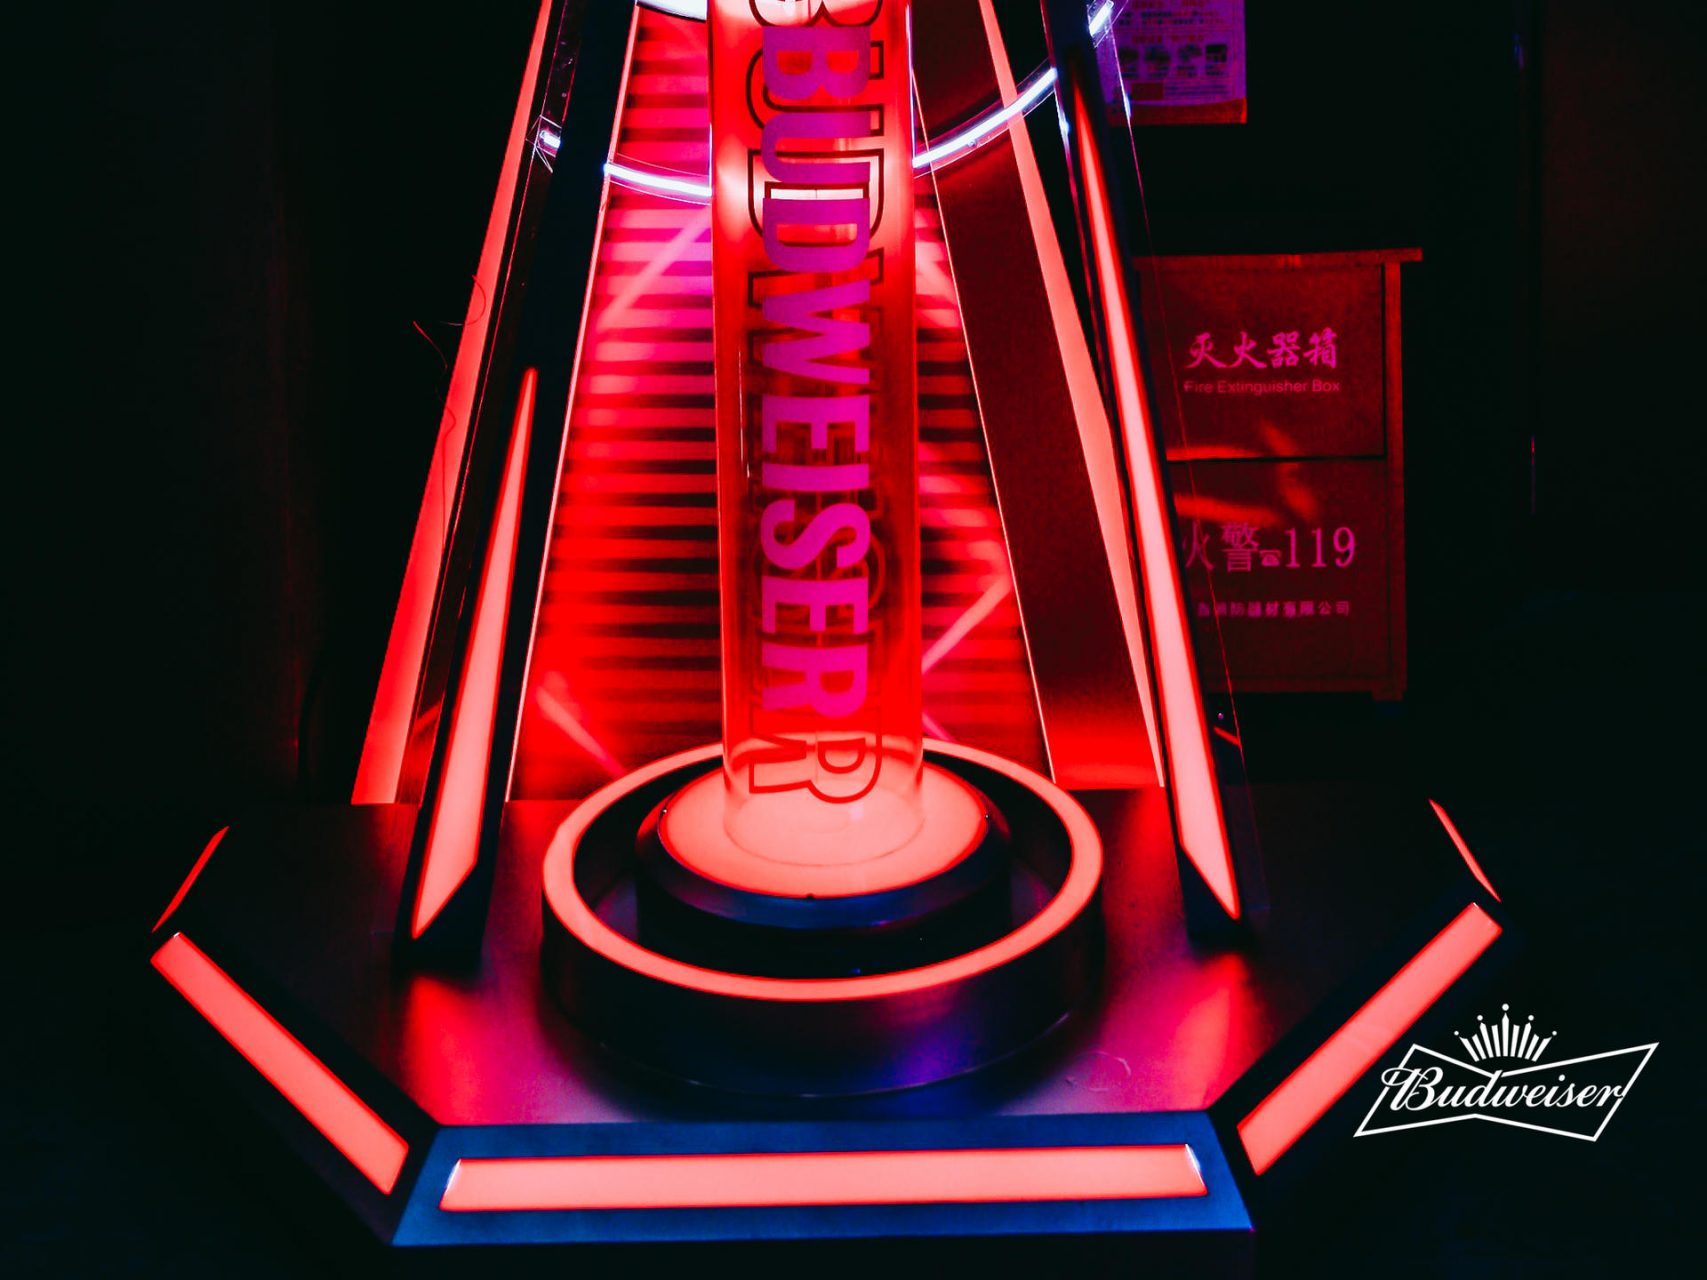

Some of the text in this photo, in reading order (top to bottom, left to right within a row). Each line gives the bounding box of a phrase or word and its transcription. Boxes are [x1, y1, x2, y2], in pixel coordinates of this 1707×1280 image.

[1185, 327, 1339, 370] 灭火器箱
[760, 25, 873, 718] BUDWEISER
[1184, 379, 1340, 396] Fire Extinguisher Box
[1284, 526, 1356, 568] 119
